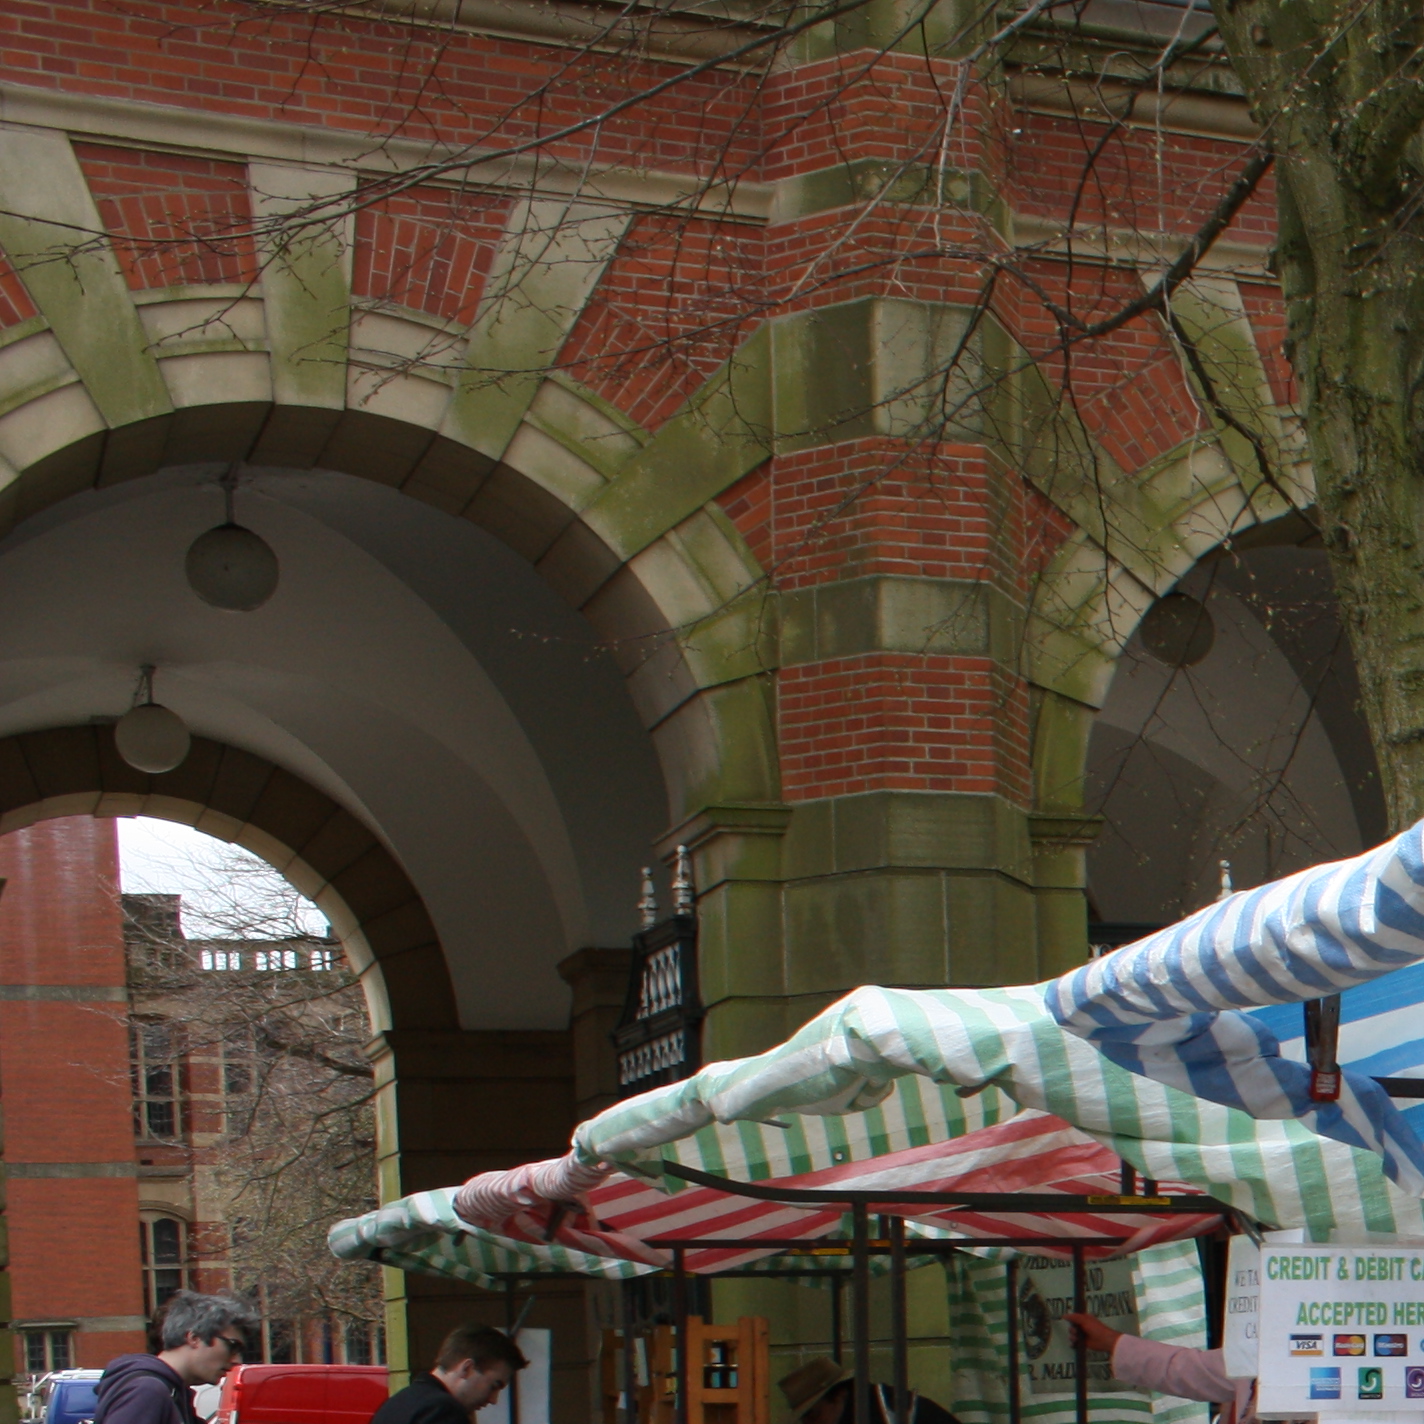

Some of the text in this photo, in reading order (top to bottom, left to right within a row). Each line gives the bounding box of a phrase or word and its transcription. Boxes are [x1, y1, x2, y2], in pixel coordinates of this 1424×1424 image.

[1267, 1256, 1331, 1280] CREDIT
[1337, 1257, 1350, 1280] &
[1355, 1256, 1405, 1281] DEBIT
[1296, 1302, 1388, 1325] ACCEPTED
[1296, 1341, 1317, 1349] VISA
